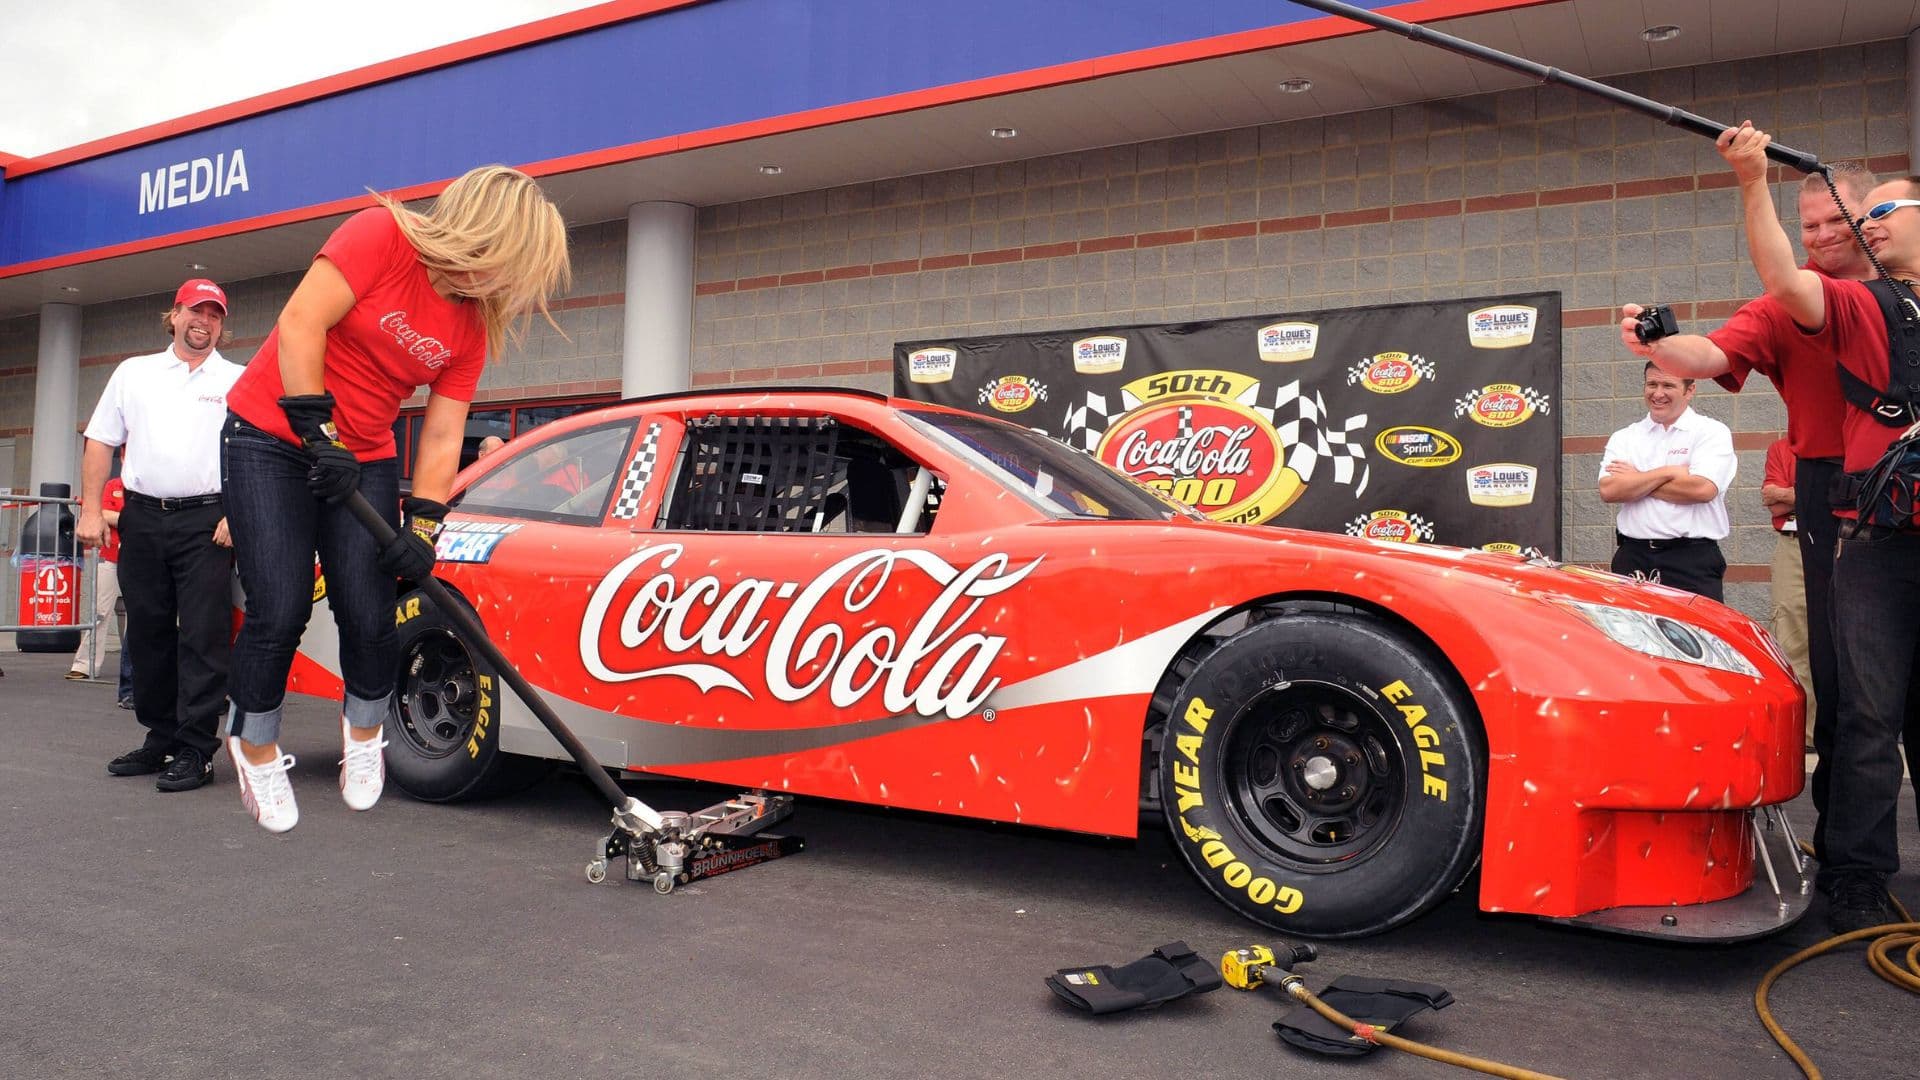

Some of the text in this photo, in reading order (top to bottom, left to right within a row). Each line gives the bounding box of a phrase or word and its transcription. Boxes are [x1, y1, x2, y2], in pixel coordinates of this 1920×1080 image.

[139, 148, 249, 214] MEDIA
[1494, 312, 1529, 322] LOWE'S
[380, 310, 451, 369] Coca-Cola
[1280, 329, 1312, 338] LOWE'S
[1093, 342, 1121, 352] LOWE'S
[1147, 374, 1232, 398] 50th
[1481, 398, 1520, 411] Coca-Cola
[1116, 424, 1256, 477] Coca-Cola
[1403, 444, 1433, 455] Sprint
[1493, 471, 1529, 481] LOWE'S
[1218, 506, 1261, 525] 09
[1369, 524, 1407, 536] Coca-Cola
[579, 543, 1046, 720] Coca-Cola
[467, 674, 492, 759] EAGLE
[1380, 680, 1447, 802] EAGLE
